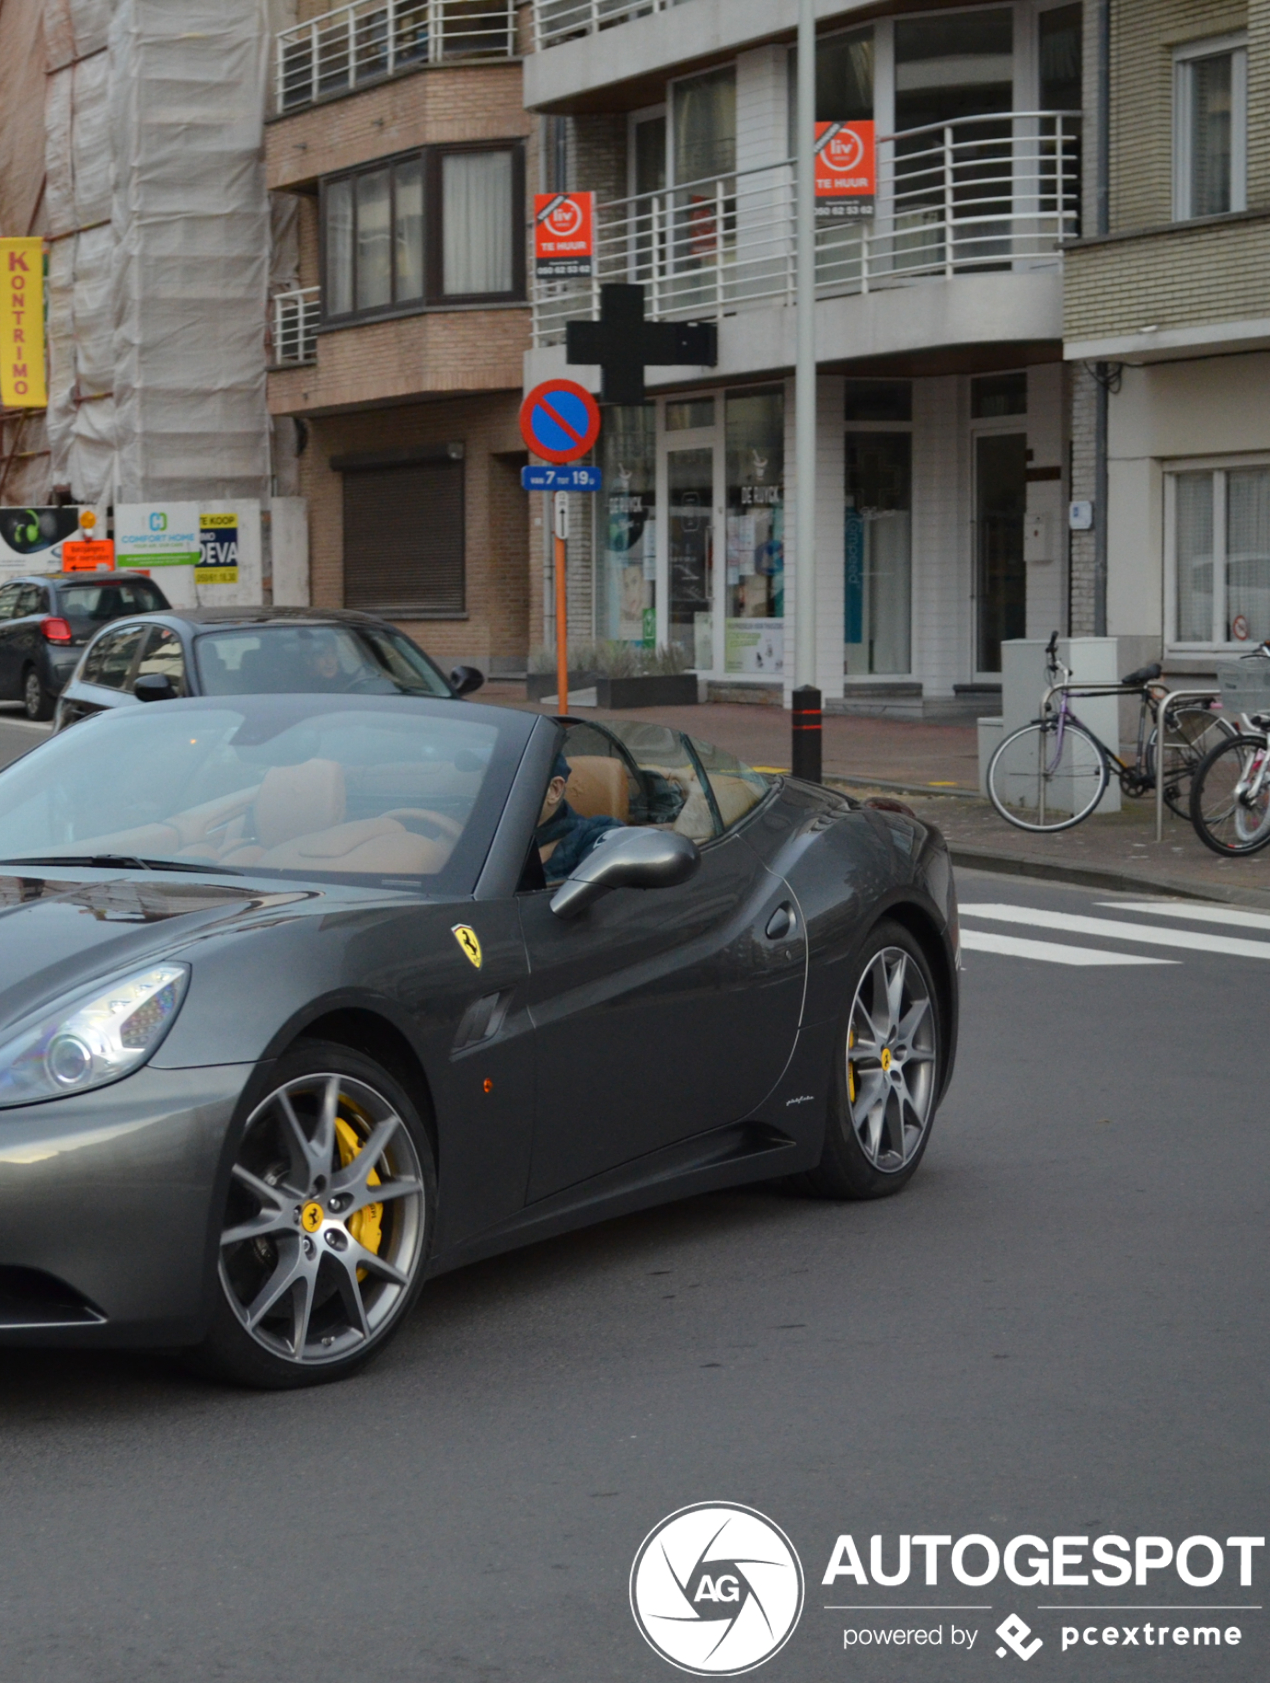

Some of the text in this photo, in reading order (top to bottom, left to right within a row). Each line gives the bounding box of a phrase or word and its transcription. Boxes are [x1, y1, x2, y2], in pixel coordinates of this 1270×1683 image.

[816, 178, 869, 189] TE HUUR
[541, 241, 587, 251] TE HUUR
[8, 251, 29, 396] KONTRIMO
[545, 471, 556, 485] 7
[741, 486, 752, 504] DE
[210, 516, 235, 525] KOOP
[121, 533, 194, 543] COMFORT HOME
